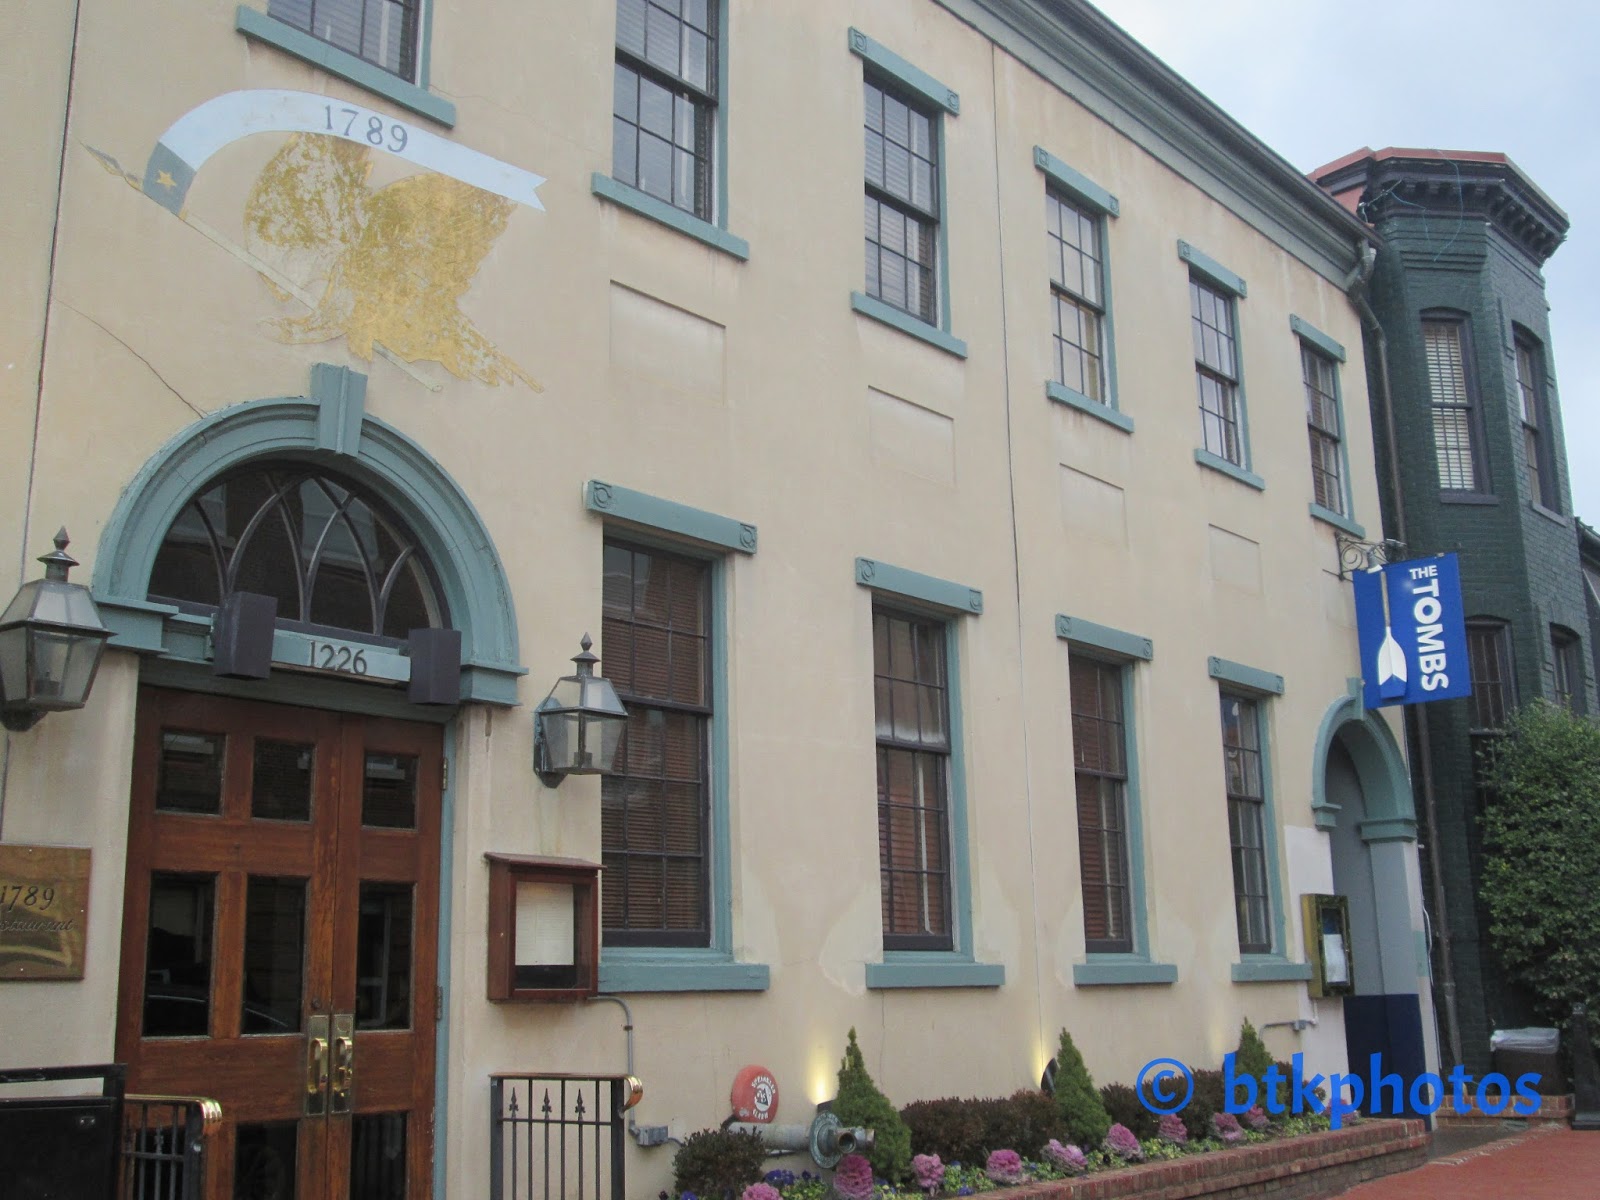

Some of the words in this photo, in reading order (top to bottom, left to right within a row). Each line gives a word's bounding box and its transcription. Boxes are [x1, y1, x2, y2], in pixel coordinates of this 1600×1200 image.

[325, 104, 408, 153] 1789
[1409, 565, 1438, 580] THE
[1412, 578, 1449, 691] TOMBS
[310, 640, 368, 675] 1226
[0, 885, 55, 911] 1789
